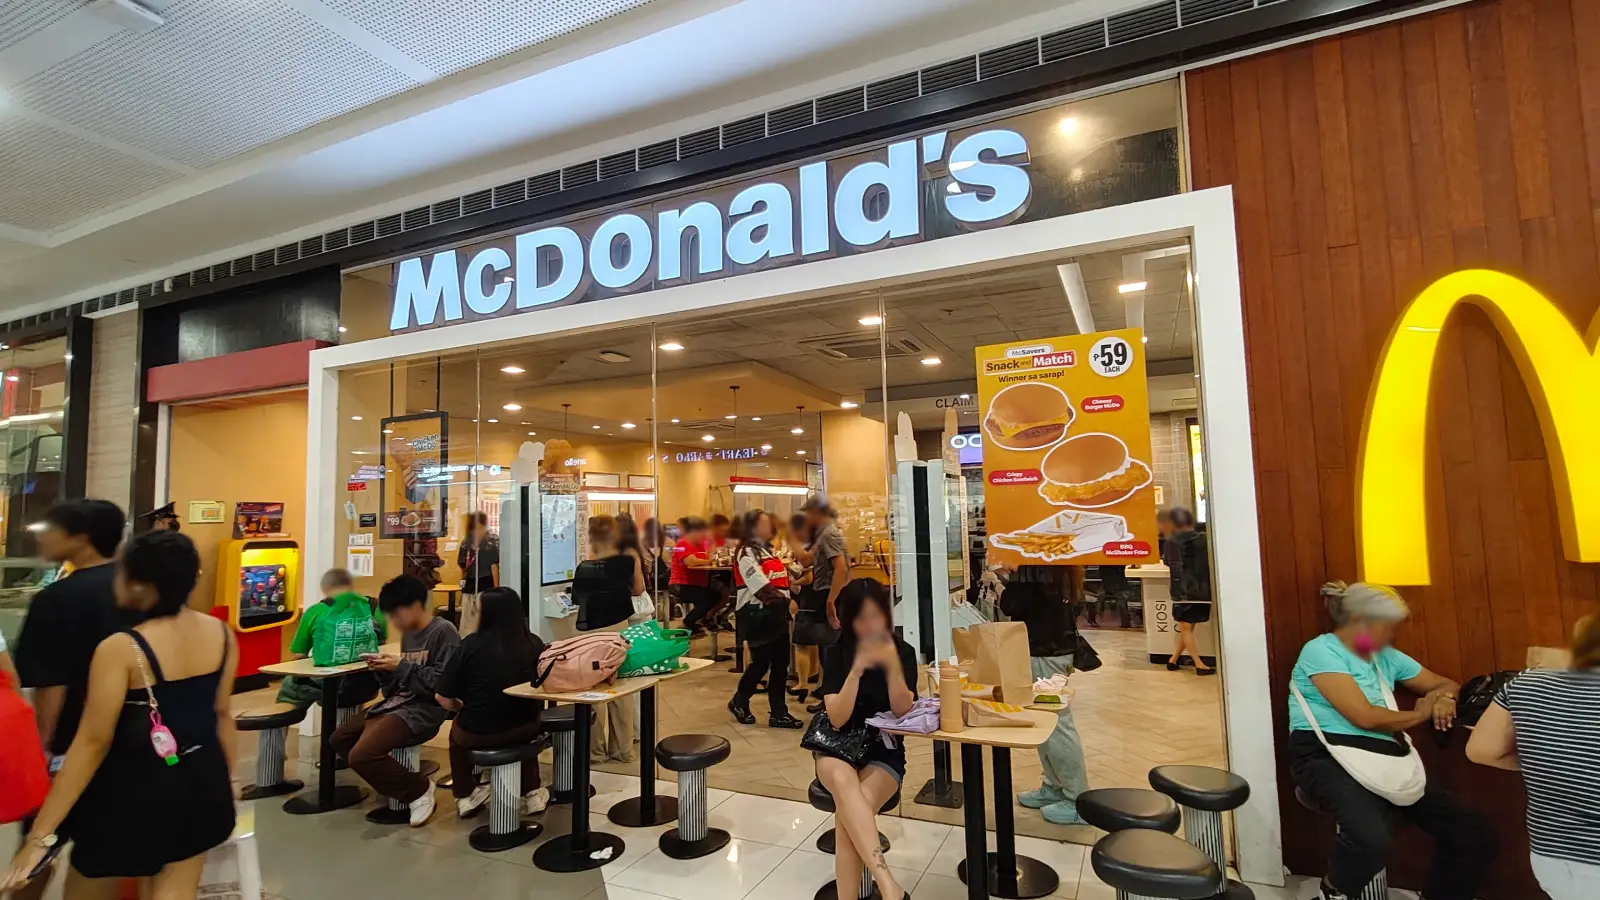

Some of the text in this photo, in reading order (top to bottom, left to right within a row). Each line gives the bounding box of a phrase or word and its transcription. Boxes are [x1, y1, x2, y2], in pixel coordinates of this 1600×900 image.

[390, 129, 1031, 331] McDonald's
[1011, 347, 1045, 356] McSavers
[986, 360, 1020, 371] Snack
[1033, 352, 1073, 367] Match
[998, 375, 1026, 383] Winner
[1039, 370, 1065, 380] sarap!
[935, 395, 974, 408] CLAIM
